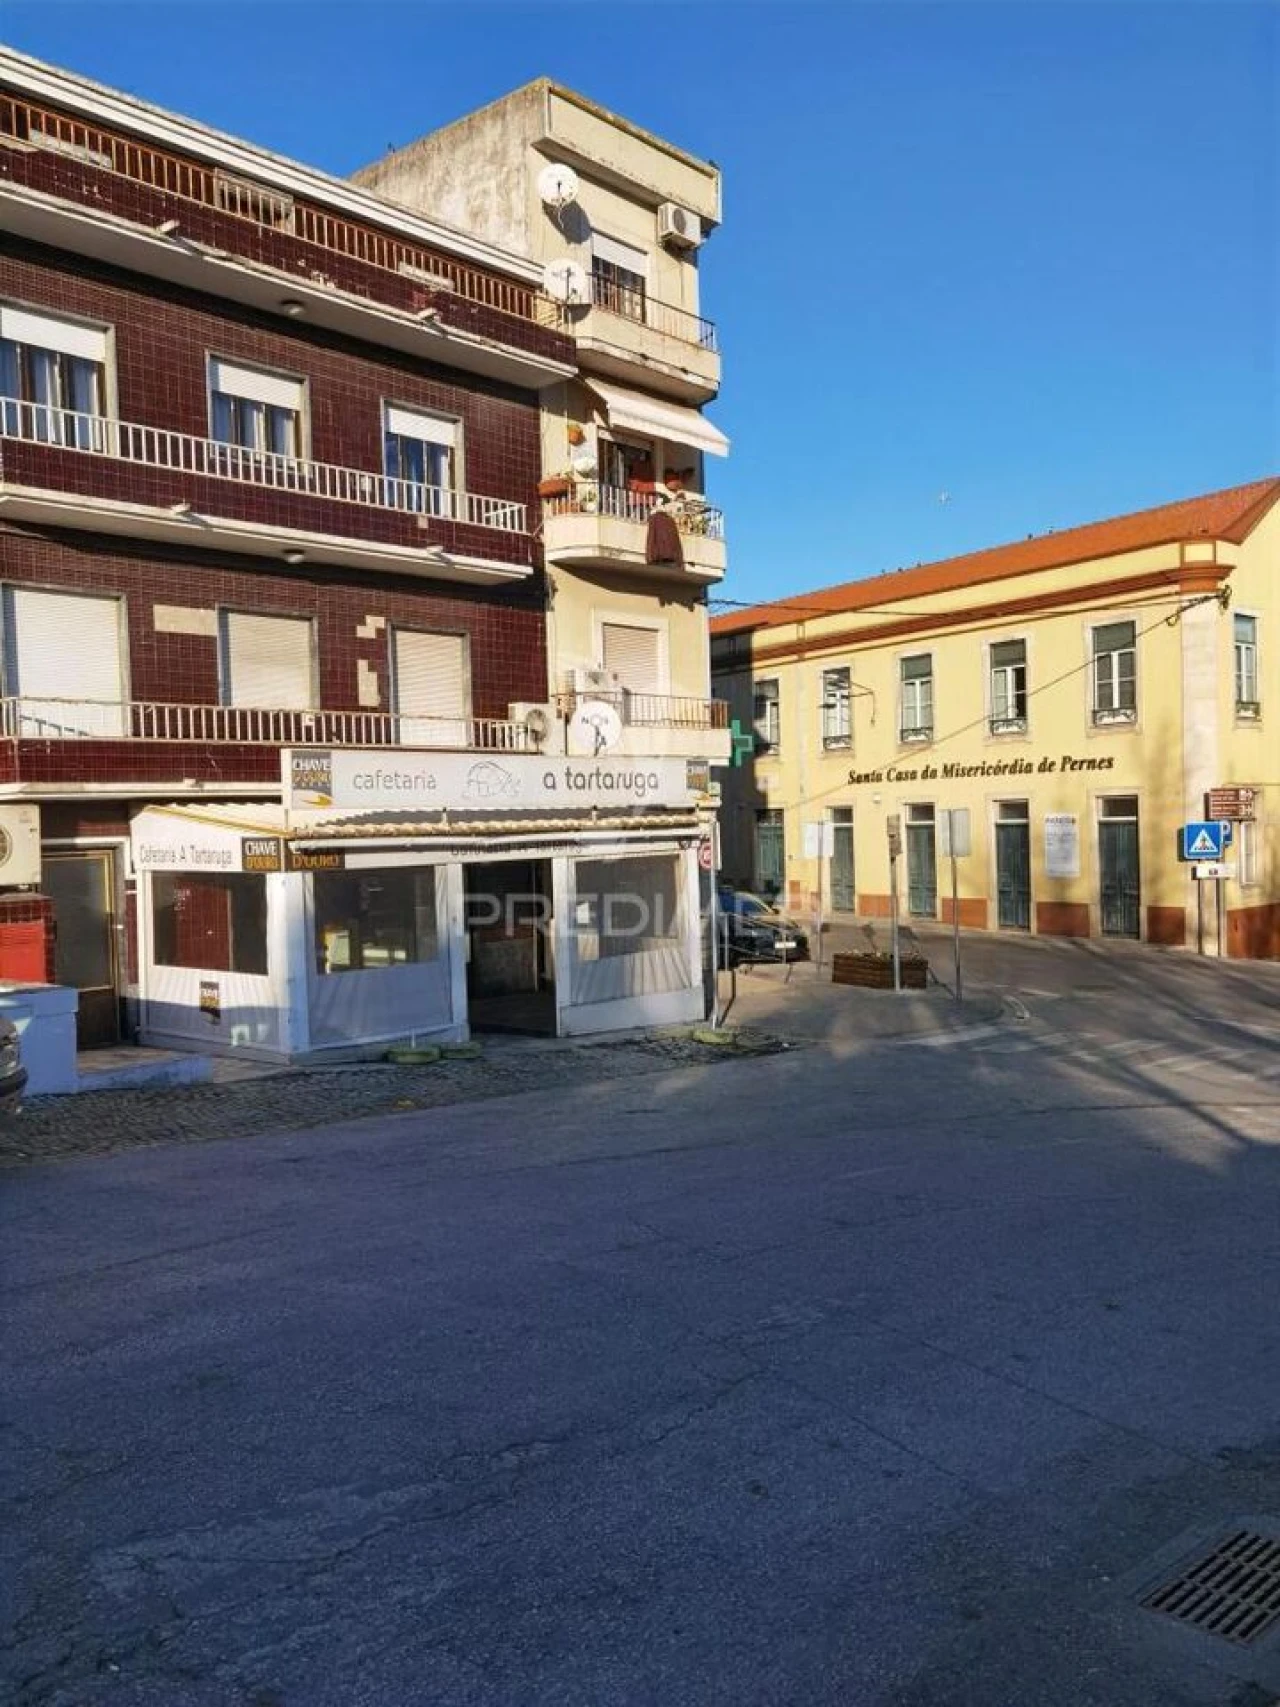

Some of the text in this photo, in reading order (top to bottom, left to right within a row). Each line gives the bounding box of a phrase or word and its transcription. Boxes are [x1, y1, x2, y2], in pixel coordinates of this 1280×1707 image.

[353, 770, 436, 791] cafetaria
[543, 772, 557, 791] a
[565, 765, 659, 797] tartaruga
[848, 755, 1115, 784] Santa Casa da Misericórdia de Pernes
[245, 841, 277, 856] CHAVE
